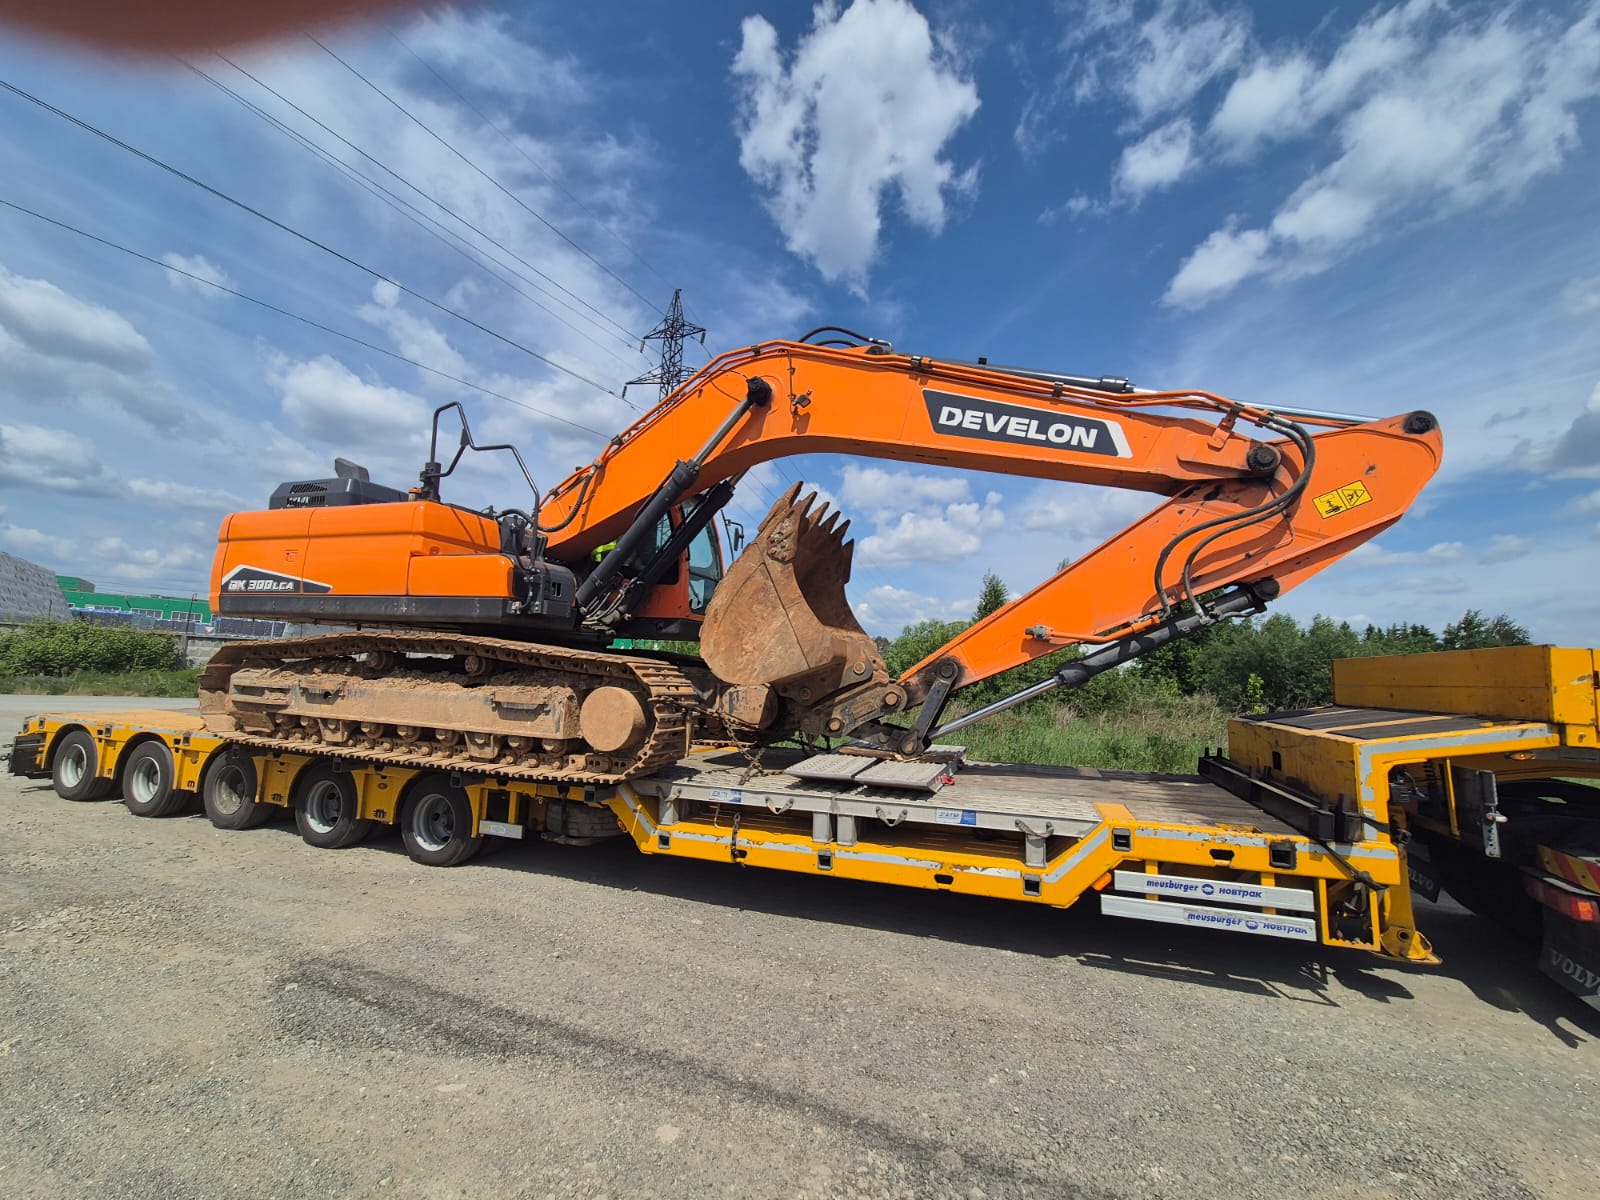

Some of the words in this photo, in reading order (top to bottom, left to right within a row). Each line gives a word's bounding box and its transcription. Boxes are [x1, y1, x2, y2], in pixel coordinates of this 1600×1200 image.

[938, 406, 1098, 448] DEVELON
[1146, 880, 1199, 893] meusburger
[1219, 887, 1262, 899] новтрак
